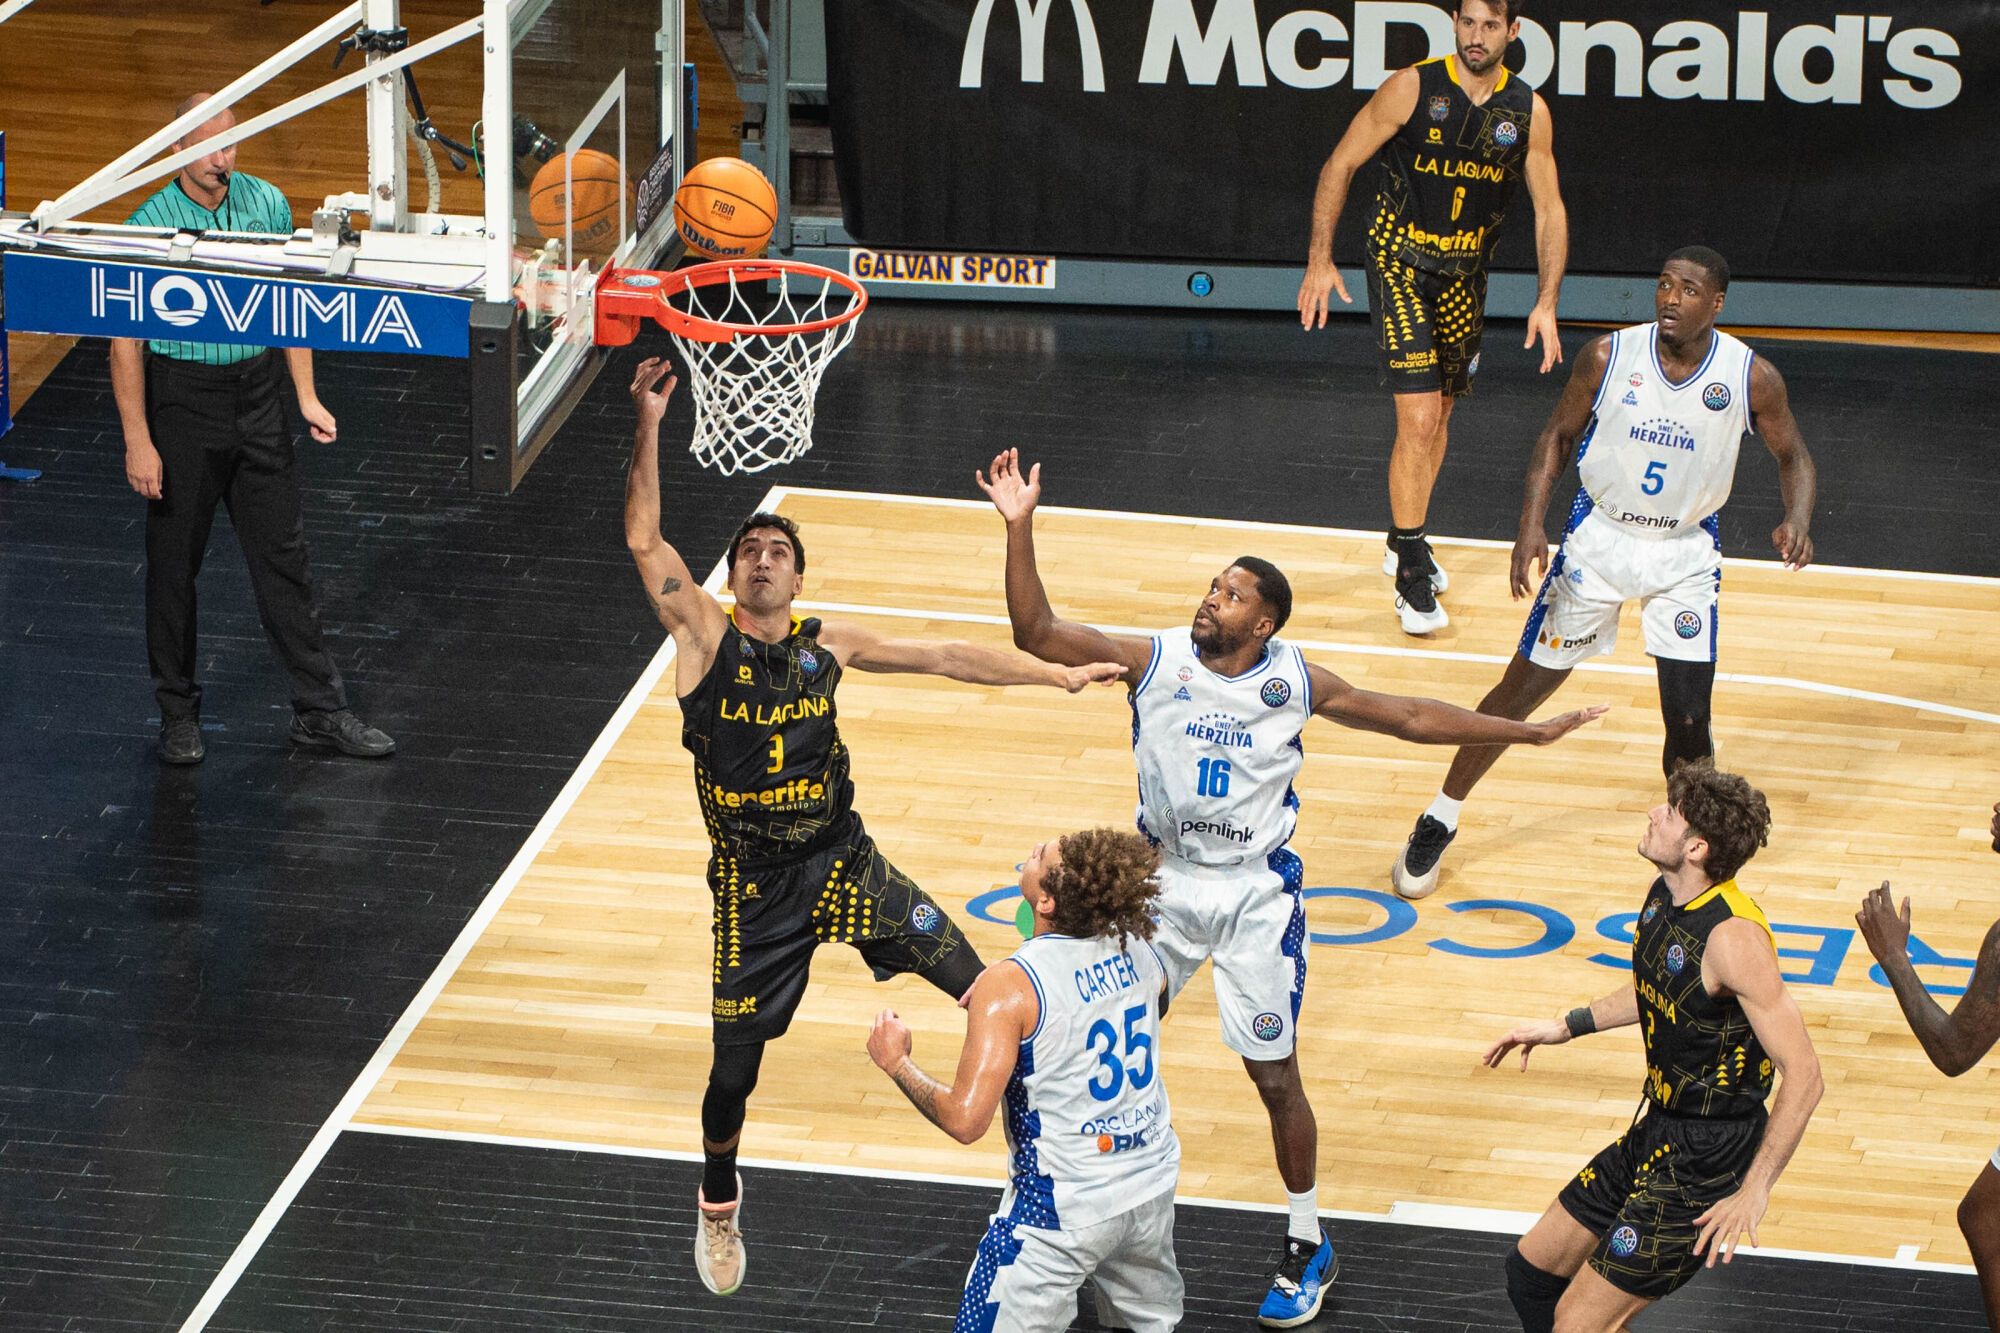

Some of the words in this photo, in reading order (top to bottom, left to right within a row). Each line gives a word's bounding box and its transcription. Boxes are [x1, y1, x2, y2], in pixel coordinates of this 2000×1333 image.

[1414, 153, 1438, 175] LA
[712, 199, 736, 216] FIBA
[1451, 186, 1466, 221] 6
[682, 220, 746, 254] Wilson
[855, 252, 954, 282] GALVAN
[962, 255, 1049, 285] SPORT
[91, 267, 422, 349] HOVIMA
[1629, 426, 1695, 451] HERZLIYA
[1641, 461, 1667, 496] 5
[720, 698, 750, 723] LA
[1185, 722, 1253, 748] HERZLIYA
[767, 734, 784, 774] 3
[1197, 757, 1231, 798] 16
[1180, 820, 1255, 843] penlink
[1074, 952, 1140, 1003] CARTER
[1647, 1010, 1655, 1049] 2
[1086, 1002, 1154, 1102] 35
